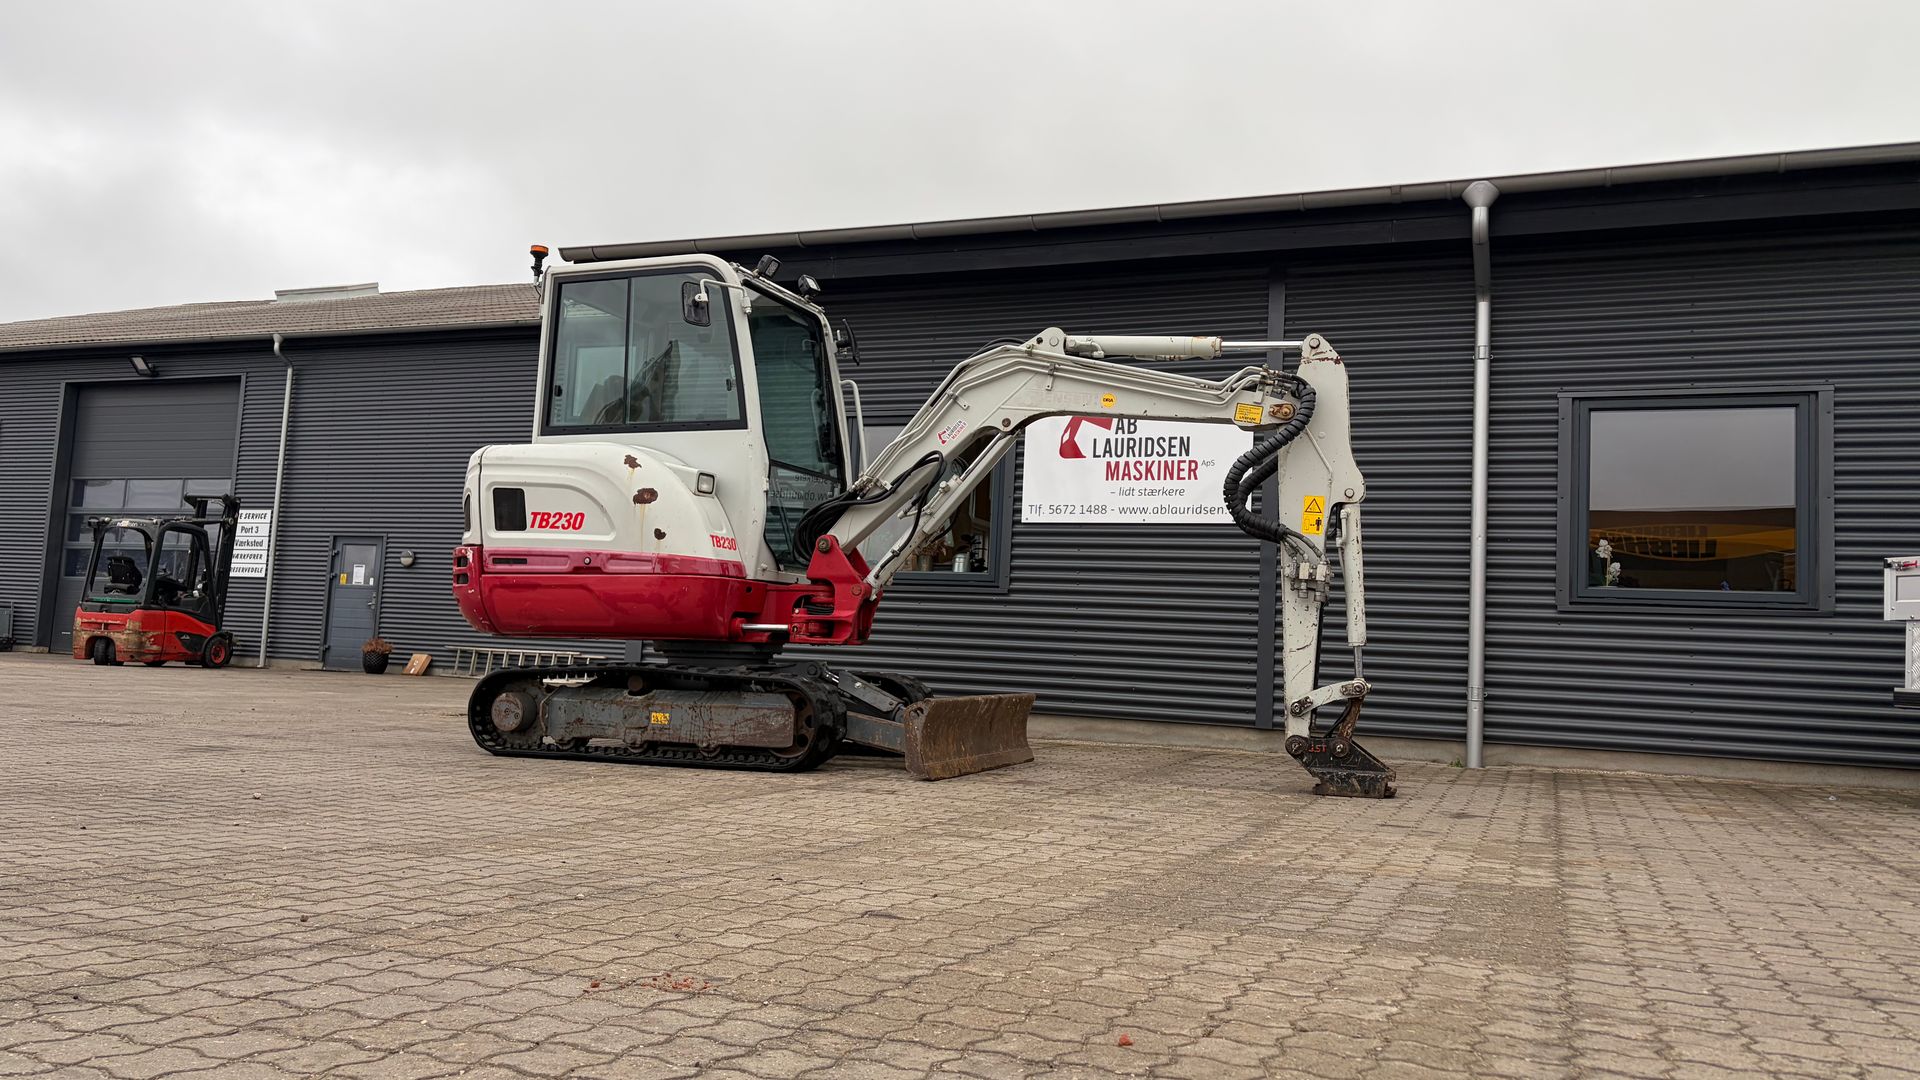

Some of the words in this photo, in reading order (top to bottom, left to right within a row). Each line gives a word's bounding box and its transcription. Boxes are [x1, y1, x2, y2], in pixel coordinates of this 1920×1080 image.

[1115, 418, 1138, 435] AB
[1093, 436, 1191, 459] LAURIDSEN
[1105, 459, 1199, 482] MASKINER
[1201, 459, 1216, 468] ApS
[1118, 486, 1135, 497] lidt
[1138, 487, 1186, 497] stærkere
[1028, 504, 1045, 517] Tlf.
[1048, 504, 1076, 515] 5672
[1079, 504, 1108, 515] 1488
[1118, 503, 1228, 515] www.ablauridsen.
[529, 511, 585, 531] TB230
[241, 526, 254, 534] Port
[255, 526, 259, 534] 3
[235, 539, 264, 547] Værksted
[709, 534, 737, 551] TB230
